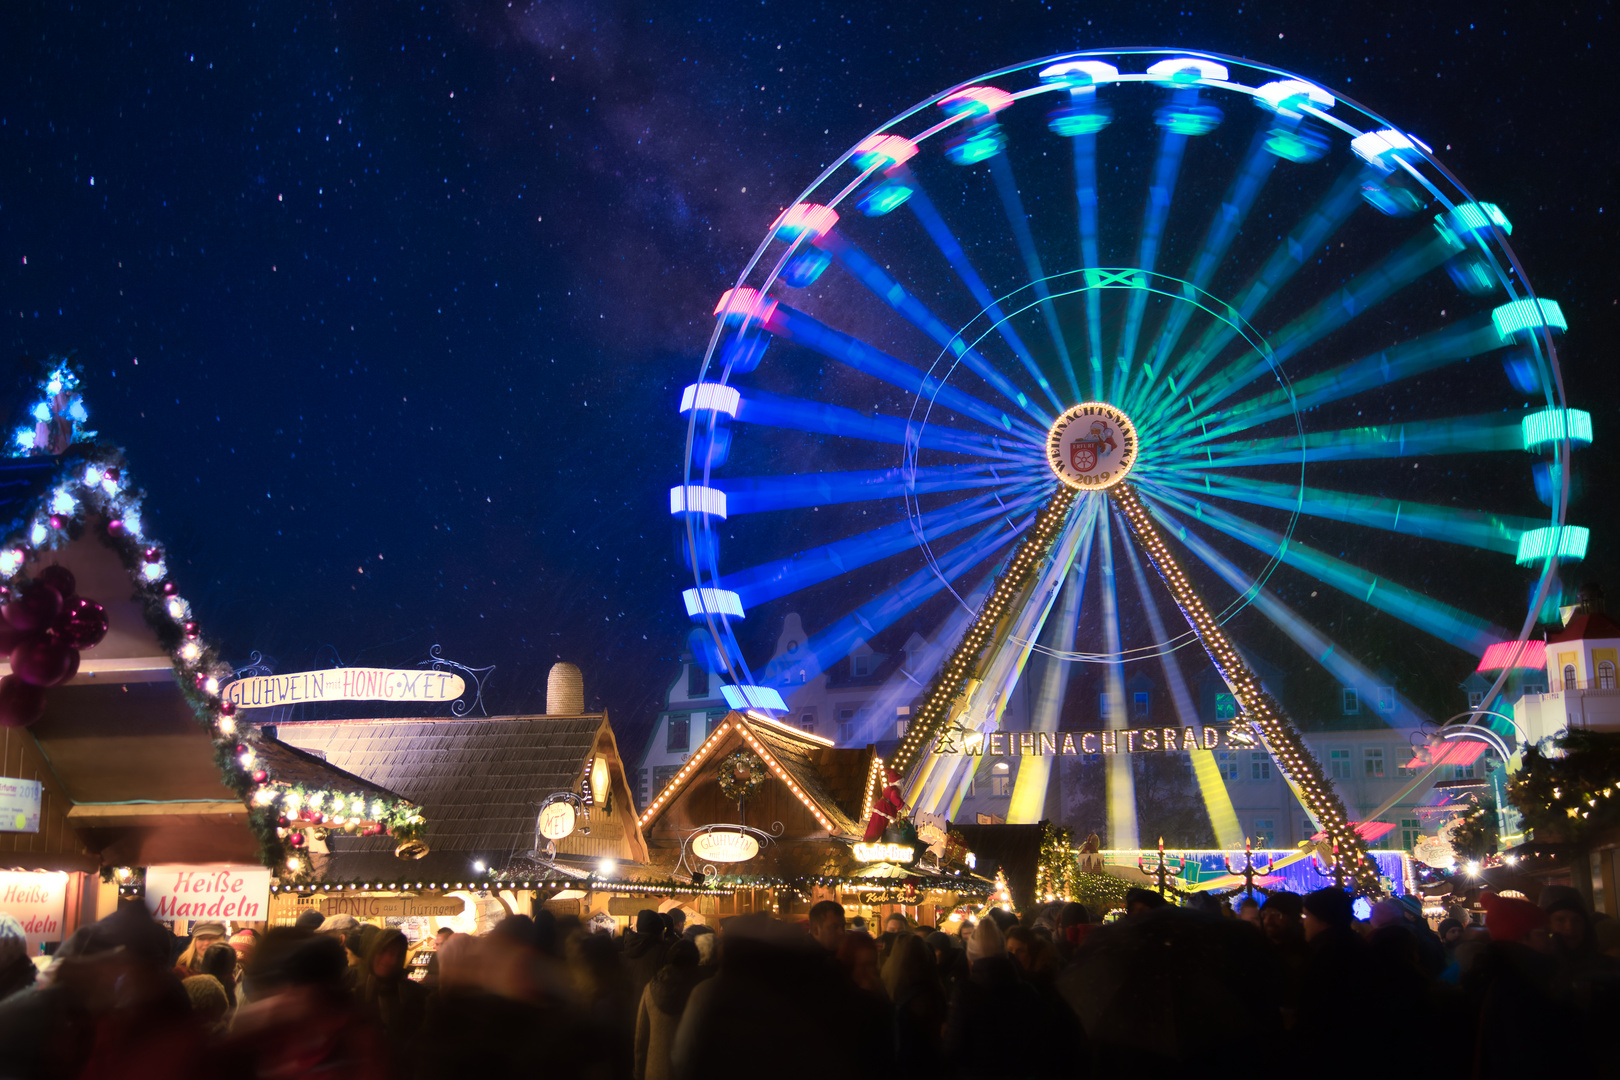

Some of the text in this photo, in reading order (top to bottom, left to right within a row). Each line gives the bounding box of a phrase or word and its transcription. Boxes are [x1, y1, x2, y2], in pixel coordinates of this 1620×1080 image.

[1050, 406, 1133, 473] WEIHNACHTSMARKT
[1074, 471, 1111, 486] 2019
[229, 672, 325, 706] GLÜHWEIN
[325, 676, 341, 690] mit
[343, 670, 395, 698] HONIG
[963, 726, 1219, 756] WEIHNACHTSRAD
[543, 812, 566, 836] MET
[173, 870, 244, 893] Heiße
[3, 884, 49, 903] Heiße
[153, 895, 260, 917] Mandeln
[383, 904, 398, 912] aus
[400, 898, 457, 917] Thüringen
[20, 914, 57, 933] deln
